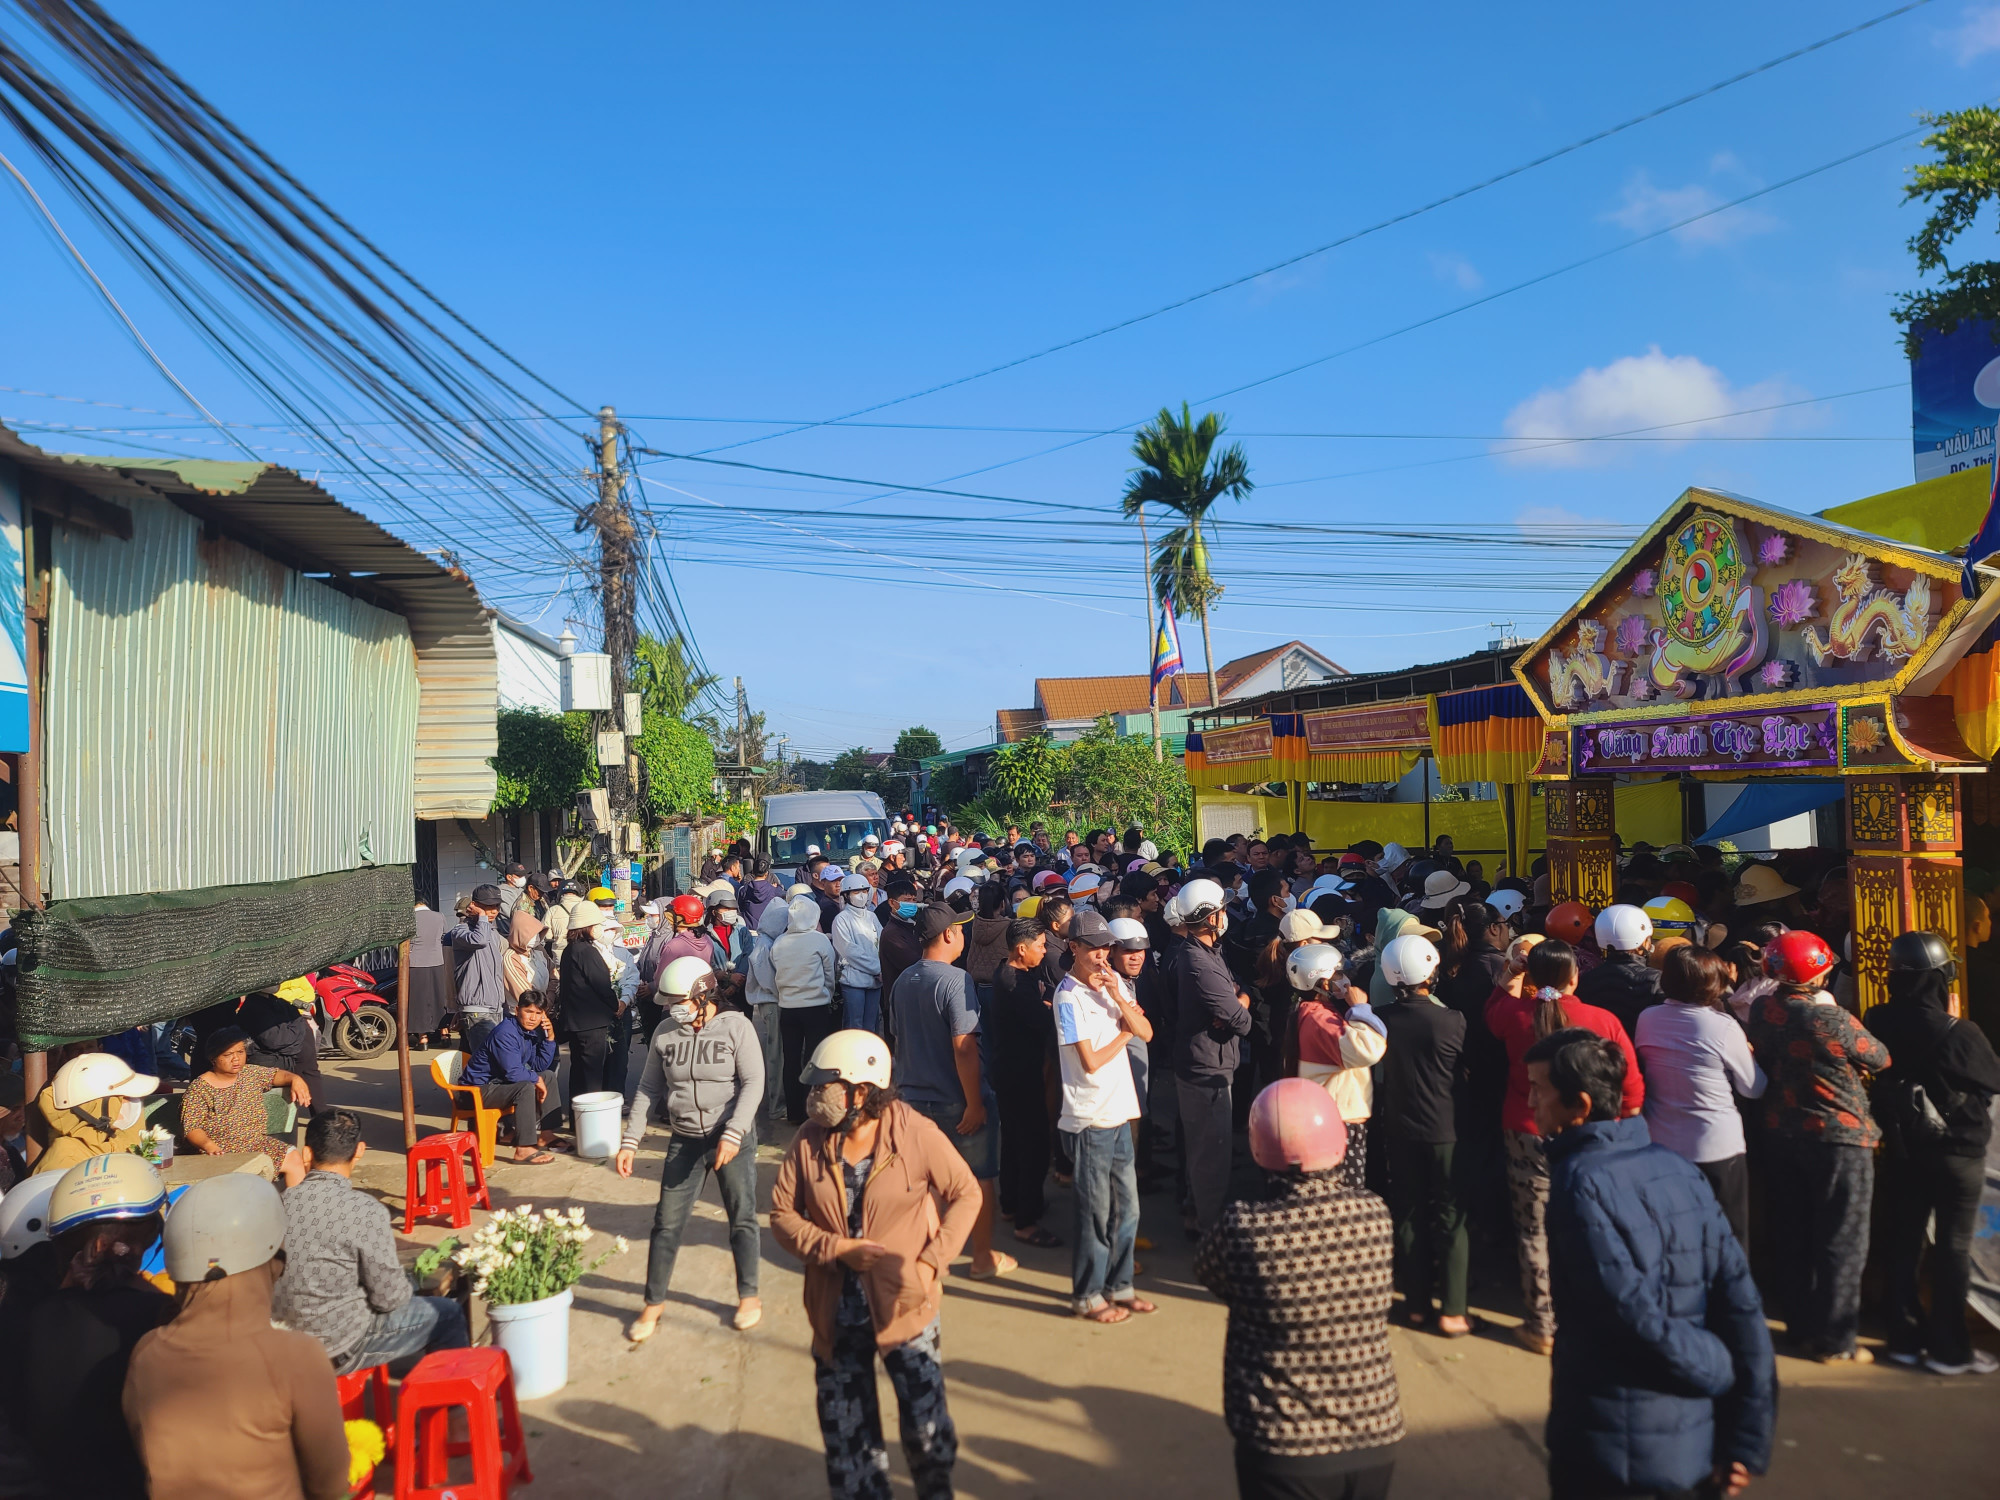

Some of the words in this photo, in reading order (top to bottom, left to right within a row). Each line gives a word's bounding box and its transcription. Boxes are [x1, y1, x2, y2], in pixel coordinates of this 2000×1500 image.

[1944, 428, 1970, 457] NẤU
[1972, 425, 1991, 449] ĂN
[1651, 725, 1701, 759] Sanh
[1762, 715, 1811, 760] Lạc
[664, 1039, 726, 1067] DUKE
